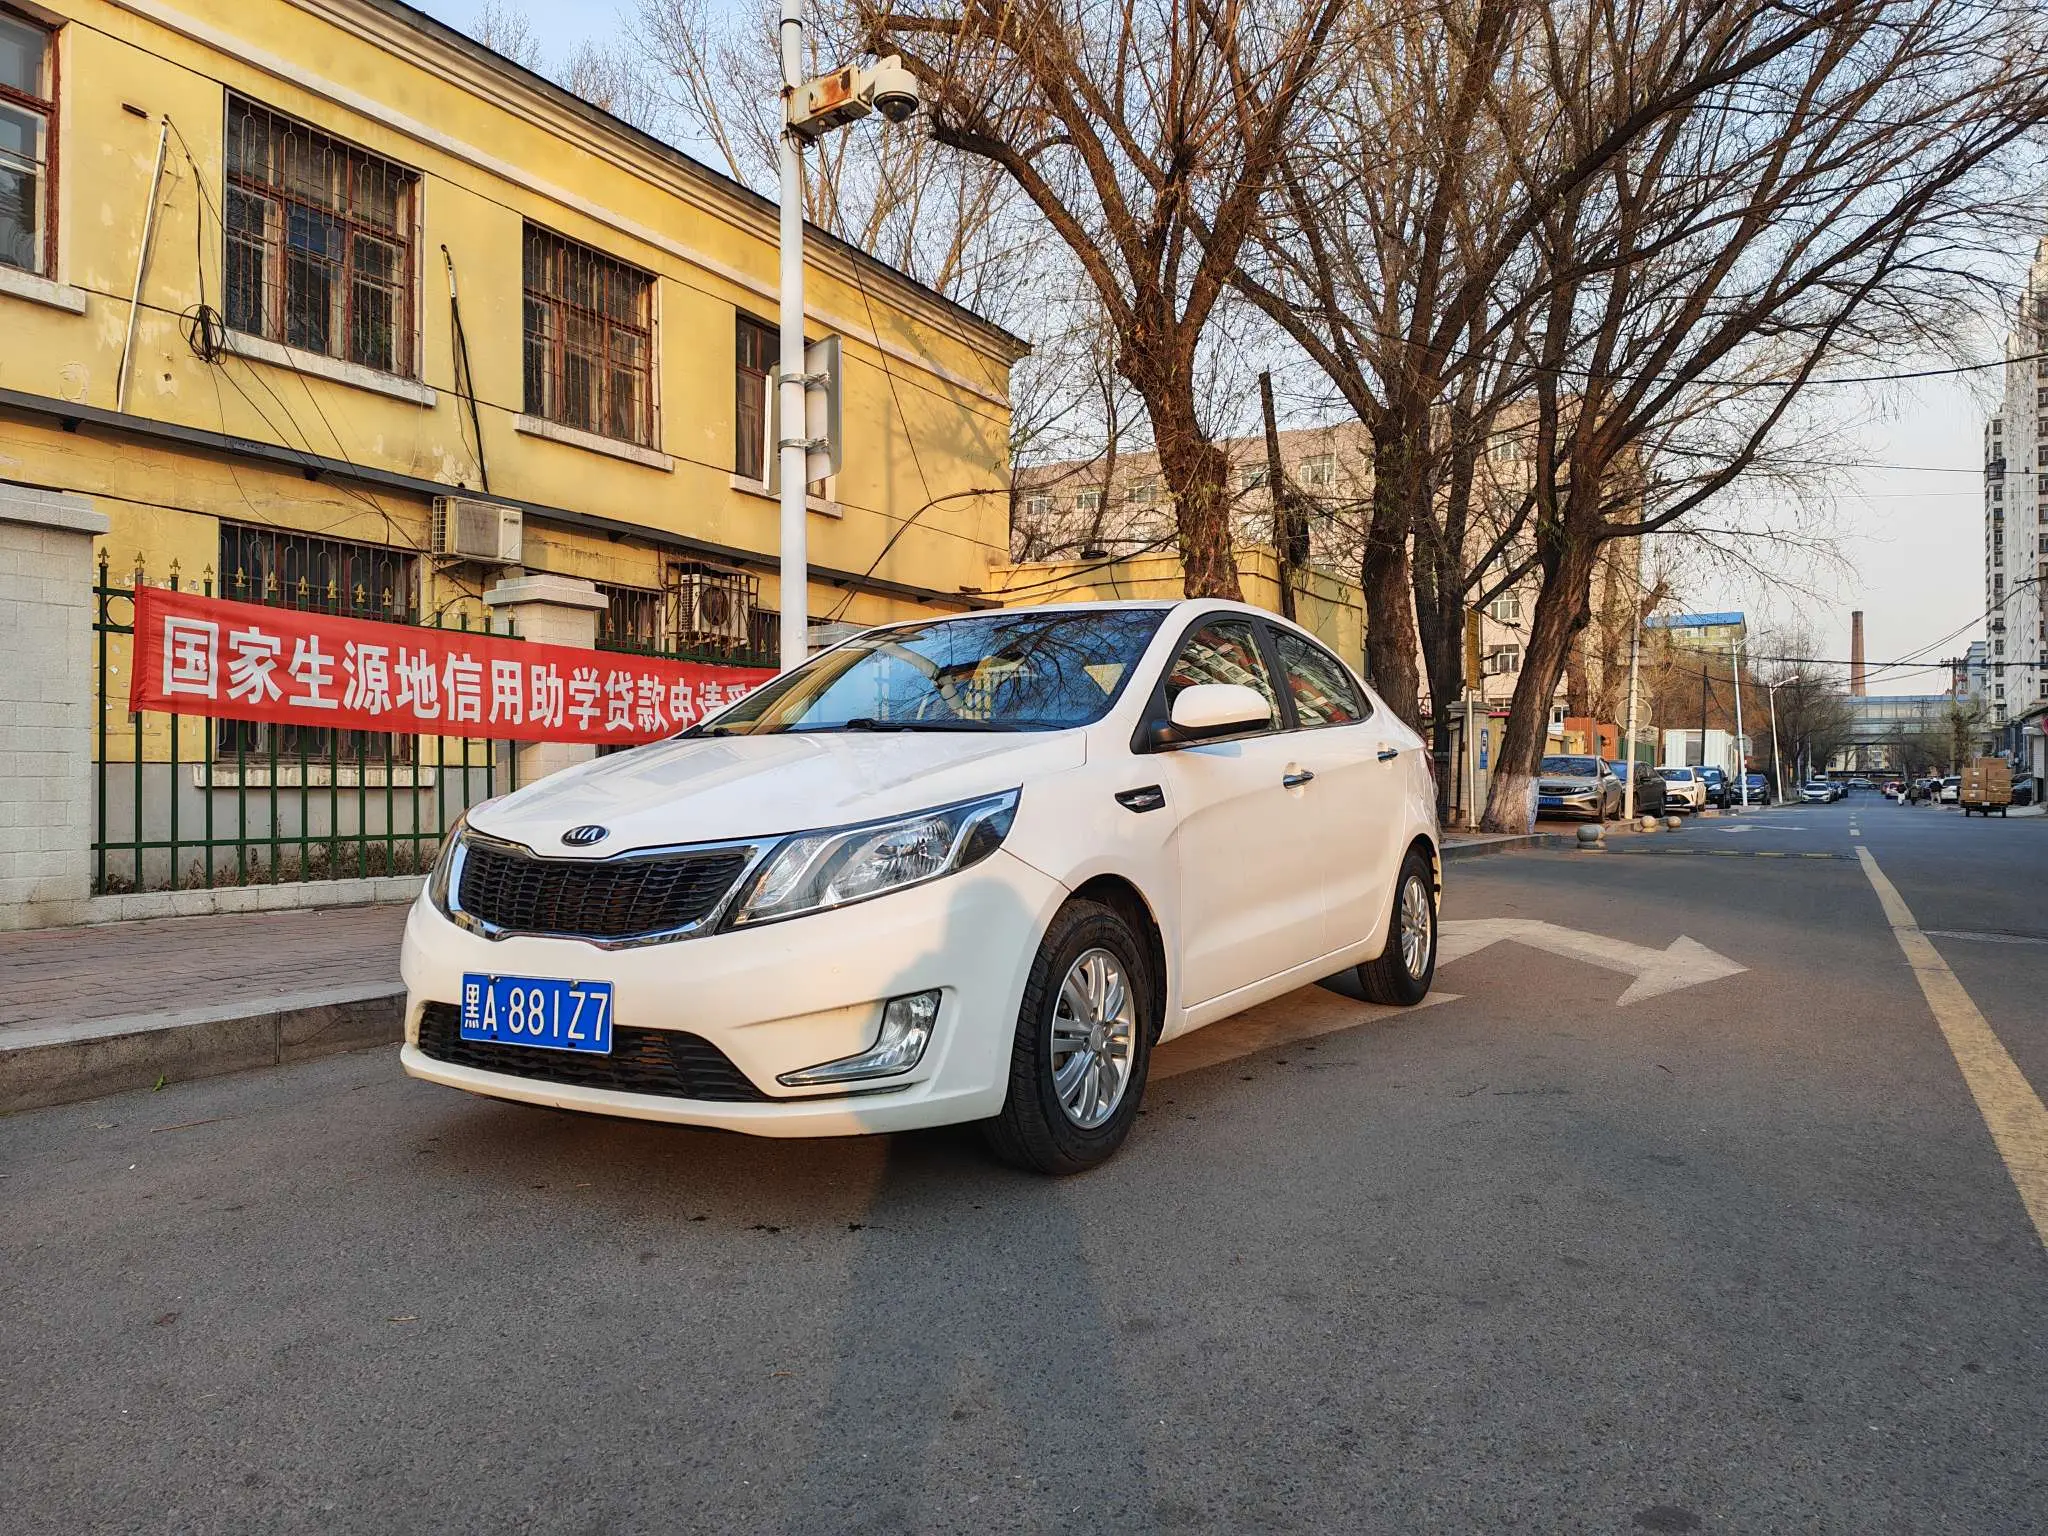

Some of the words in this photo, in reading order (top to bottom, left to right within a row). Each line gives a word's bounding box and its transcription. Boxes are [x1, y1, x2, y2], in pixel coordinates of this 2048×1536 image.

[162, 615, 758, 734] 国家生源地信用助学贷款申请
[565, 827, 600, 841] KIA
